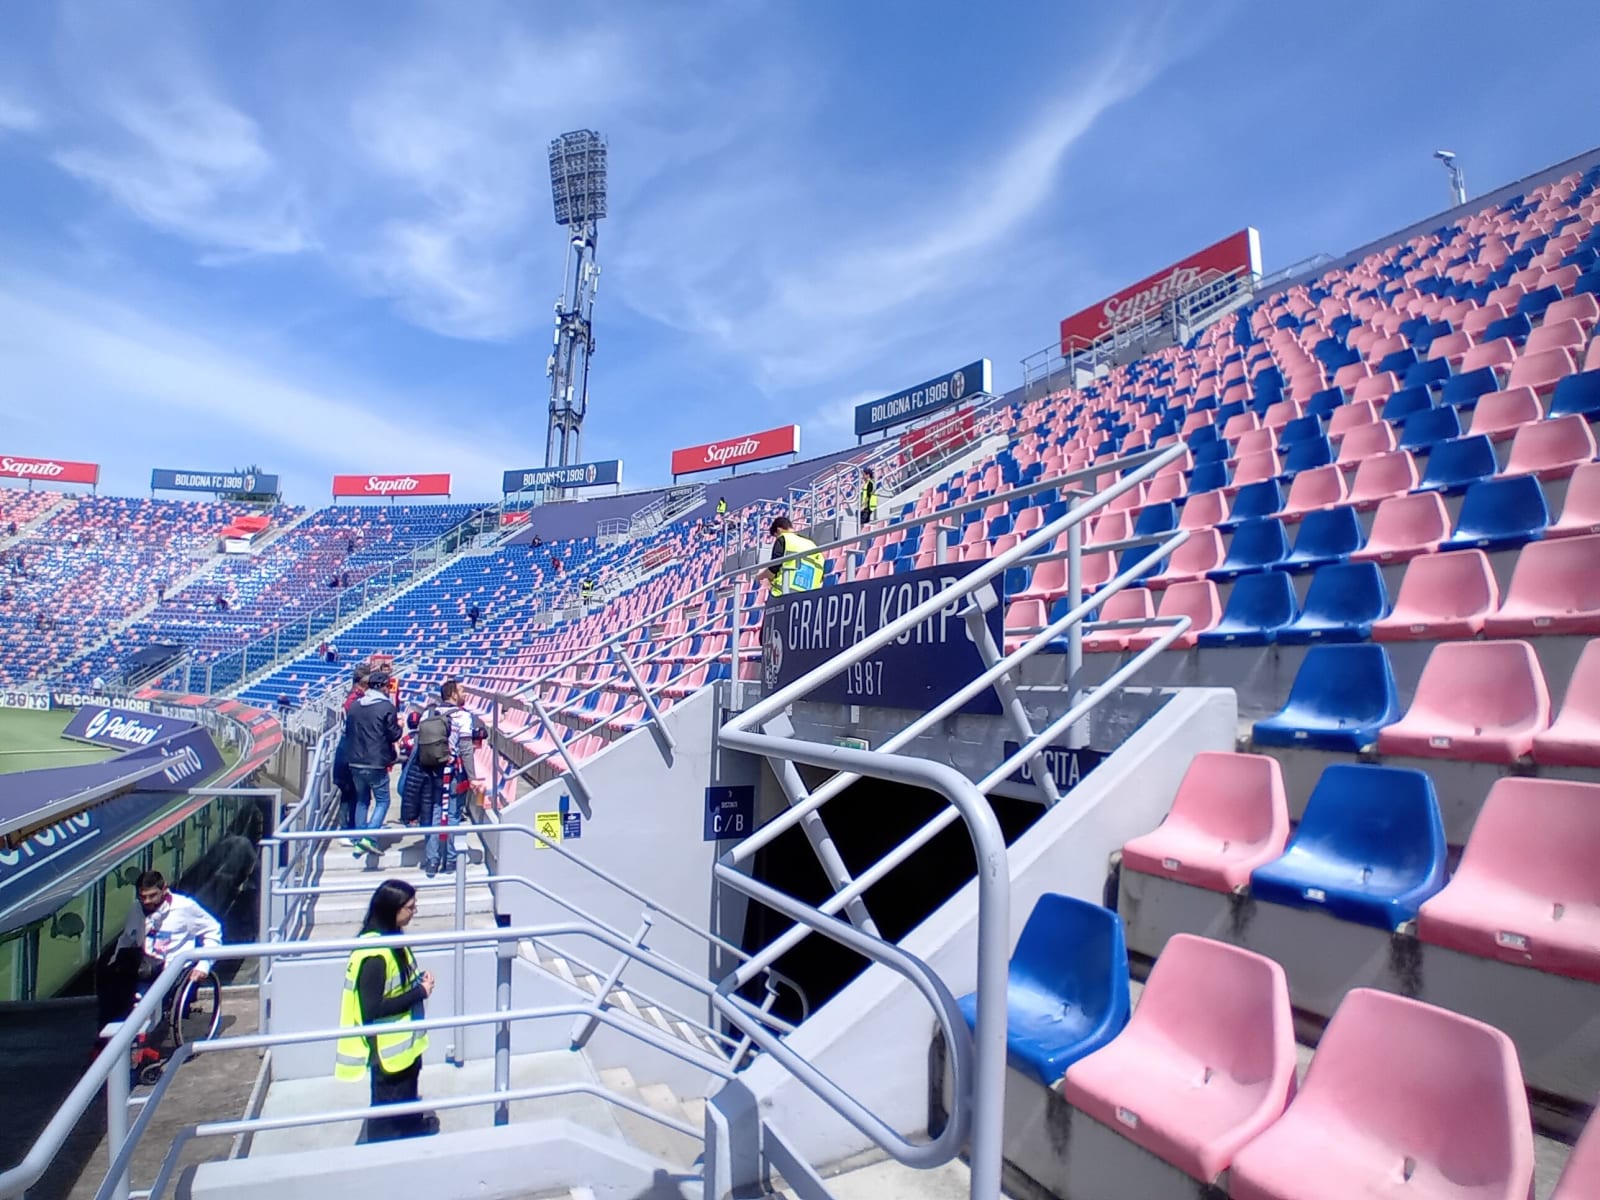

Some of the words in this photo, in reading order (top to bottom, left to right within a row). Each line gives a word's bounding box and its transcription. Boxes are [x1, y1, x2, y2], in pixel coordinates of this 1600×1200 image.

[1098, 266, 1201, 330] Saputo
[871, 396, 910, 423] BOLOGNA
[912, 390, 923, 410] FC
[924, 381, 948, 406] 1909
[703, 437, 761, 465] Saputo
[0, 457, 65, 477] Saputo
[175, 473, 211, 487] BOLOGNA
[212, 476, 223, 488] FC
[223, 477, 243, 489] 1909
[566, 468, 584, 483] 1909
[364, 476, 420, 495] Saputo
[788, 589, 867, 650] GRAPPA
[846, 661, 884, 696] 1987
[54, 693, 110, 707] VECCHIO
[112, 698, 151, 713] CUORE
[100, 716, 163, 745] Pelliconi
